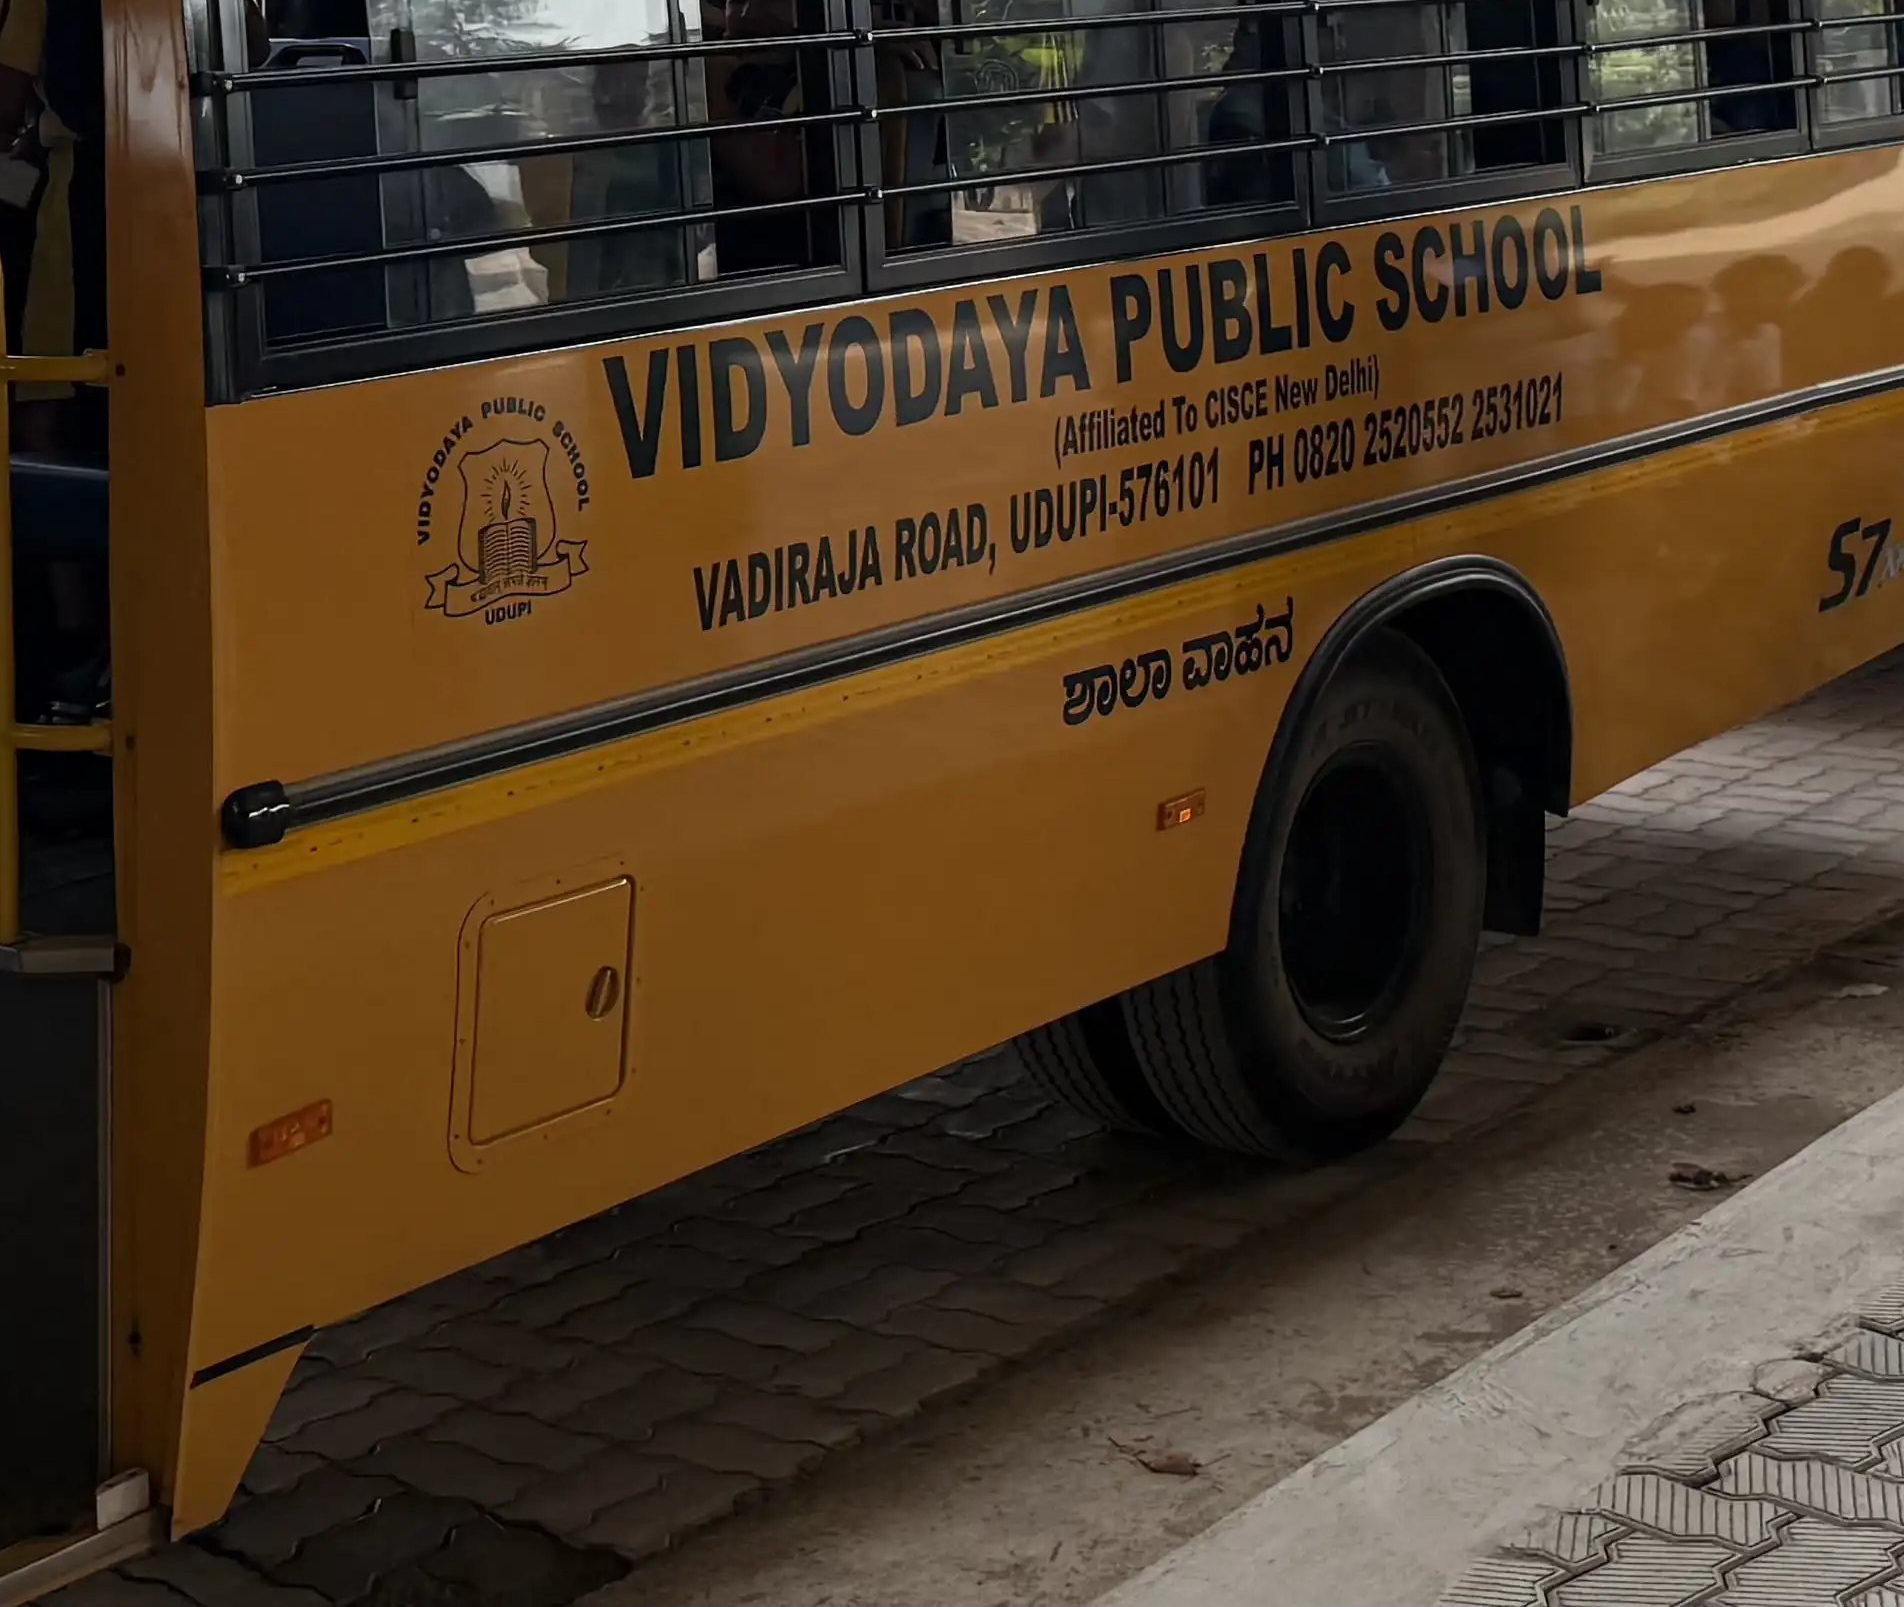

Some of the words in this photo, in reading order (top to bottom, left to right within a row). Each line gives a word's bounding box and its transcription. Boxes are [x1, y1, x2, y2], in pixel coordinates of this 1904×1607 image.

[602, 284, 1091, 479] VIDYODAYA
[1110, 241, 1354, 383] PUBLIC
[1373, 204, 1602, 332] SCHOOL
[1055, 402, 1165, 469] (Affiliated
[1173, 396, 1197, 433] To
[1205, 379, 1268, 430] CISCE
[1275, 371, 1318, 412] New
[1325, 353, 1380, 404] Delhi)
[416, 416, 473, 546] VIDYODAYA
[481, 395, 545, 420] PUBLIC
[551, 418, 590, 512] SCHOOL
[694, 524, 882, 631] VADIRAJA
[895, 501, 996, 576] ROAD,
[1010, 447, 1220, 554] UDUPI-576101
[1248, 433, 1284, 495] PH
[1294, 420, 1354, 481] 0820
[1364, 394, 1464, 466] 2520552
[1471, 372, 1563, 441] 2531021
[485, 599, 532, 625] UDUPI
[1062, 647, 1172, 726] ಶಾಲಾ
[1182, 595, 1294, 690] ವಾಹನ
